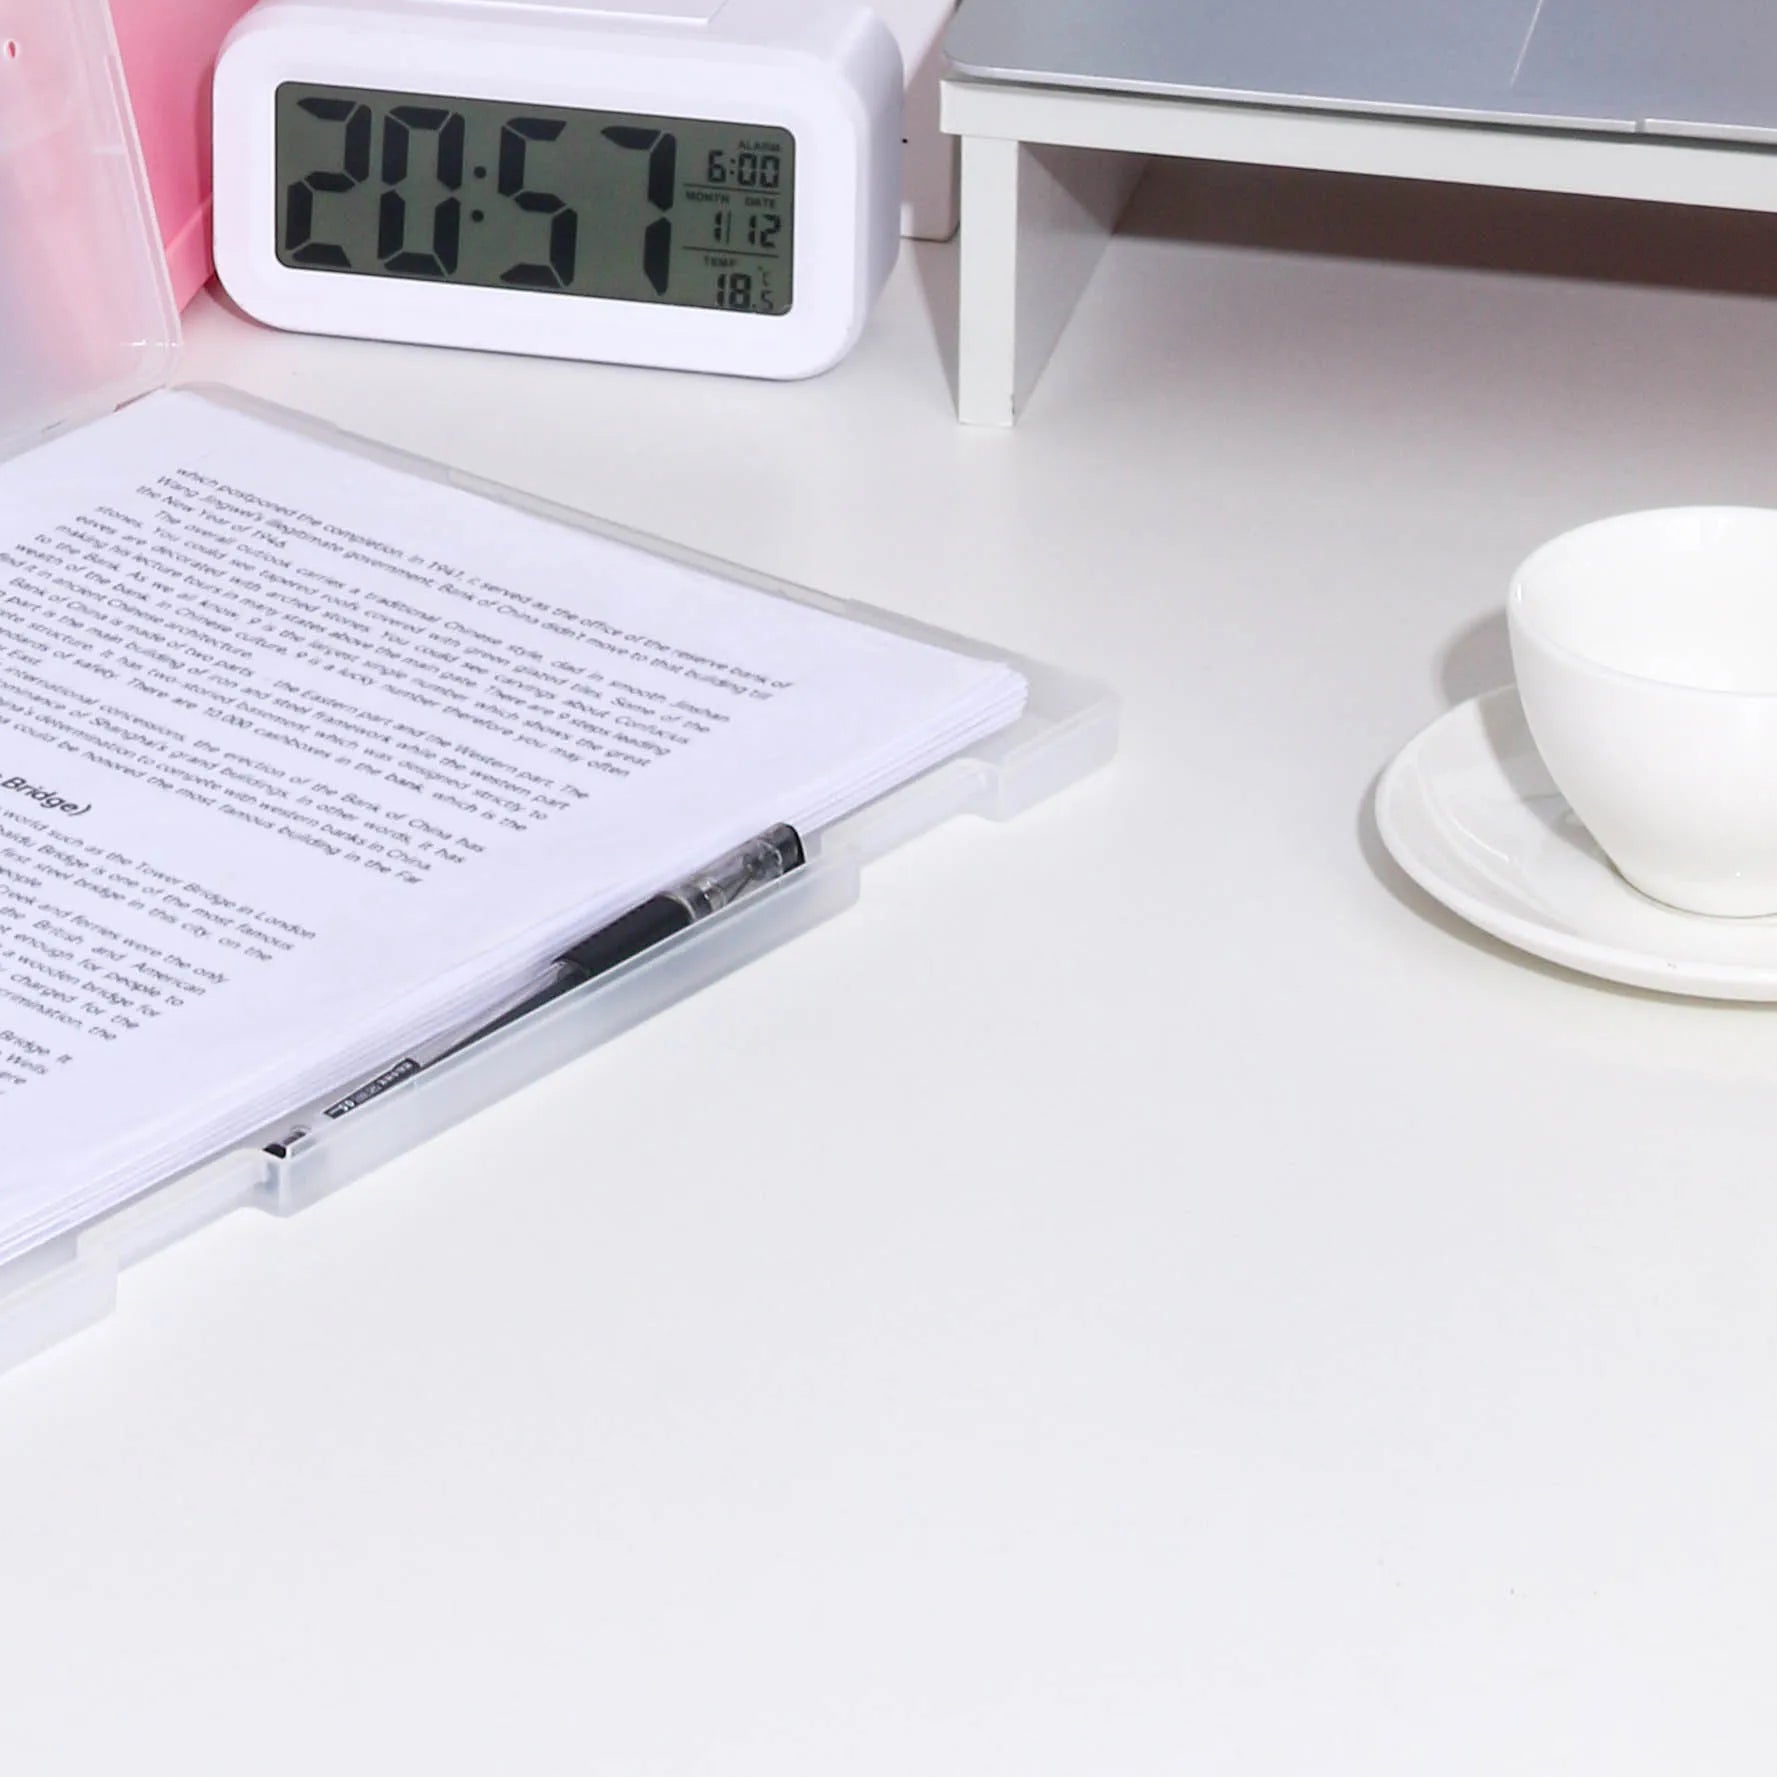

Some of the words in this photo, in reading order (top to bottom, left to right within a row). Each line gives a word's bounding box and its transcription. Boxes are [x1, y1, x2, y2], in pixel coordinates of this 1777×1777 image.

[707, 149, 780, 189] 6:00
[285, 97, 677, 295] 20:57
[686, 191, 729, 204] MONTH
[745, 197, 775, 209] DATE
[0, 776, 91, 816] Bridge)
